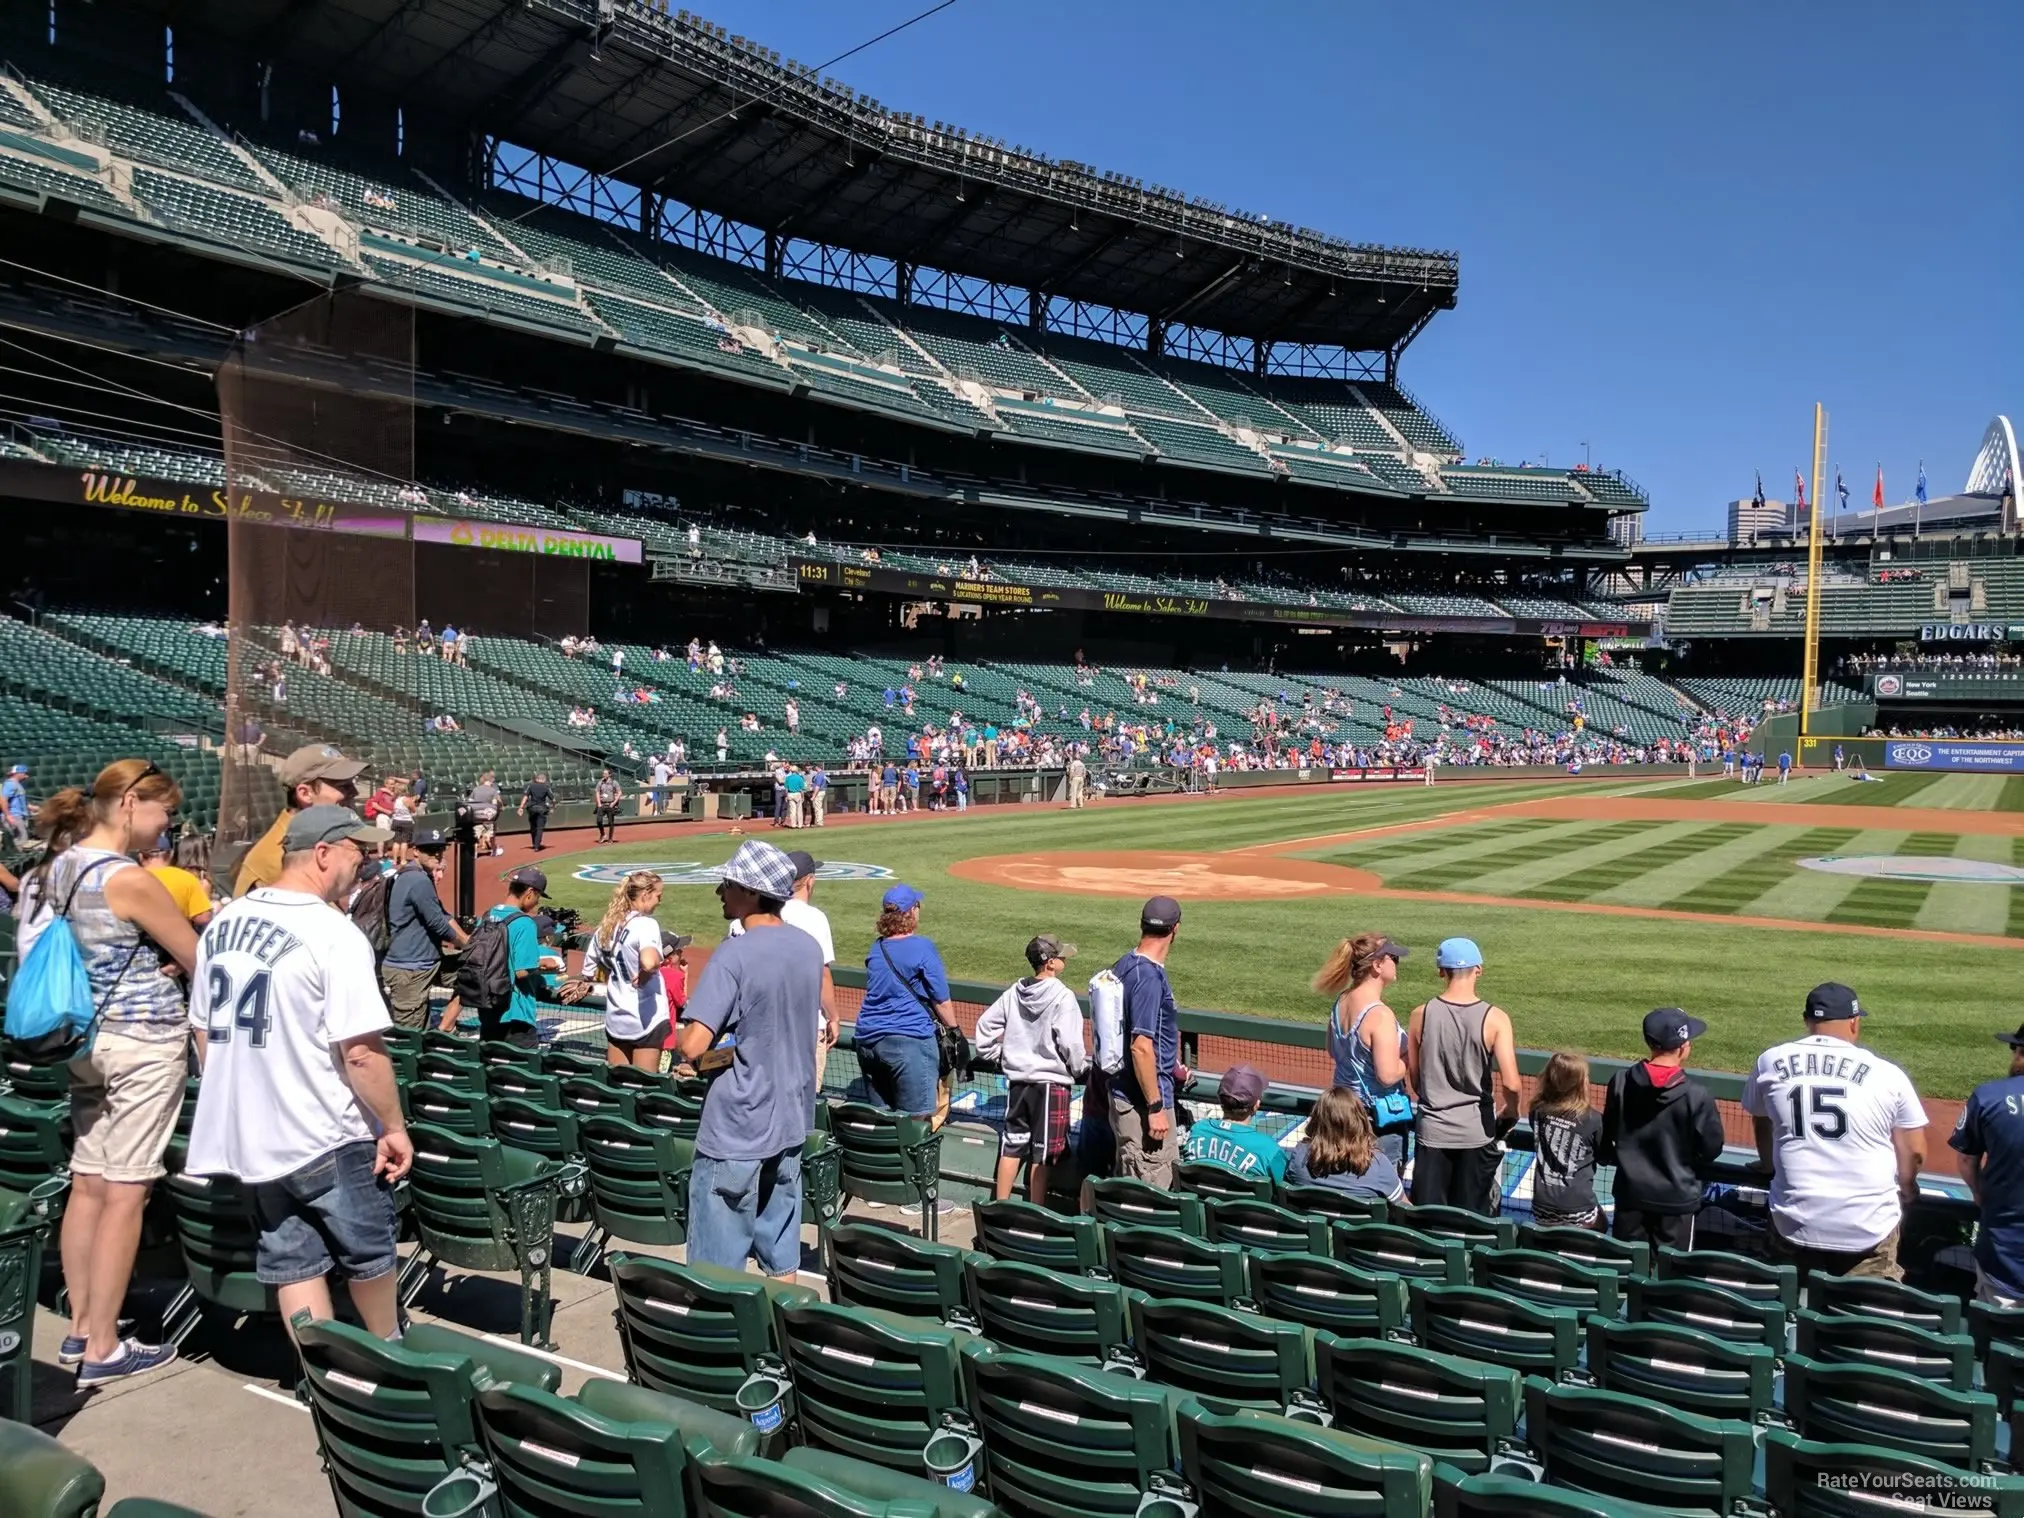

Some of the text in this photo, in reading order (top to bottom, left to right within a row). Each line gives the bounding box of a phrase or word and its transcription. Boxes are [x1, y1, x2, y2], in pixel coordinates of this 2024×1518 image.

[81, 472, 175, 513] Welcome
[180, 495, 199, 513] to
[479, 526, 617, 561] DELTA DENTAL
[800, 564, 828, 580] 11:31
[844, 567, 872, 577] Cleveland
[955, 581, 985, 592] MARINERS
[986, 585, 1004, 594] TEAM
[1005, 586, 1031, 596] STORES
[957, 590, 983, 600] LOCATIONS
[983, 592, 998, 601] OPEN
[998, 594, 1013, 602] YEAR
[1013, 595, 1033, 604] ROUND
[1104, 593, 1142, 610] Welcome
[1143, 600, 1152, 611] to
[1184, 599, 1209, 614] Field
[1921, 624, 2005, 640] EDGARS
[1804, 738, 1817, 748] 331
[1892, 748, 1932, 761] EQC
[1950, 748, 2001, 757] ENTERTAINMENT
[1973, 757, 2014, 765] NORTHWEST
[432, 829, 441, 840] S
[204, 915, 304, 969] GRIFFEY
[207, 963, 273, 1049] 24
[1773, 1053, 1872, 1087] SEAGER
[1787, 1084, 1849, 1142] 15
[1187, 1136, 1258, 1174] SEAGER
